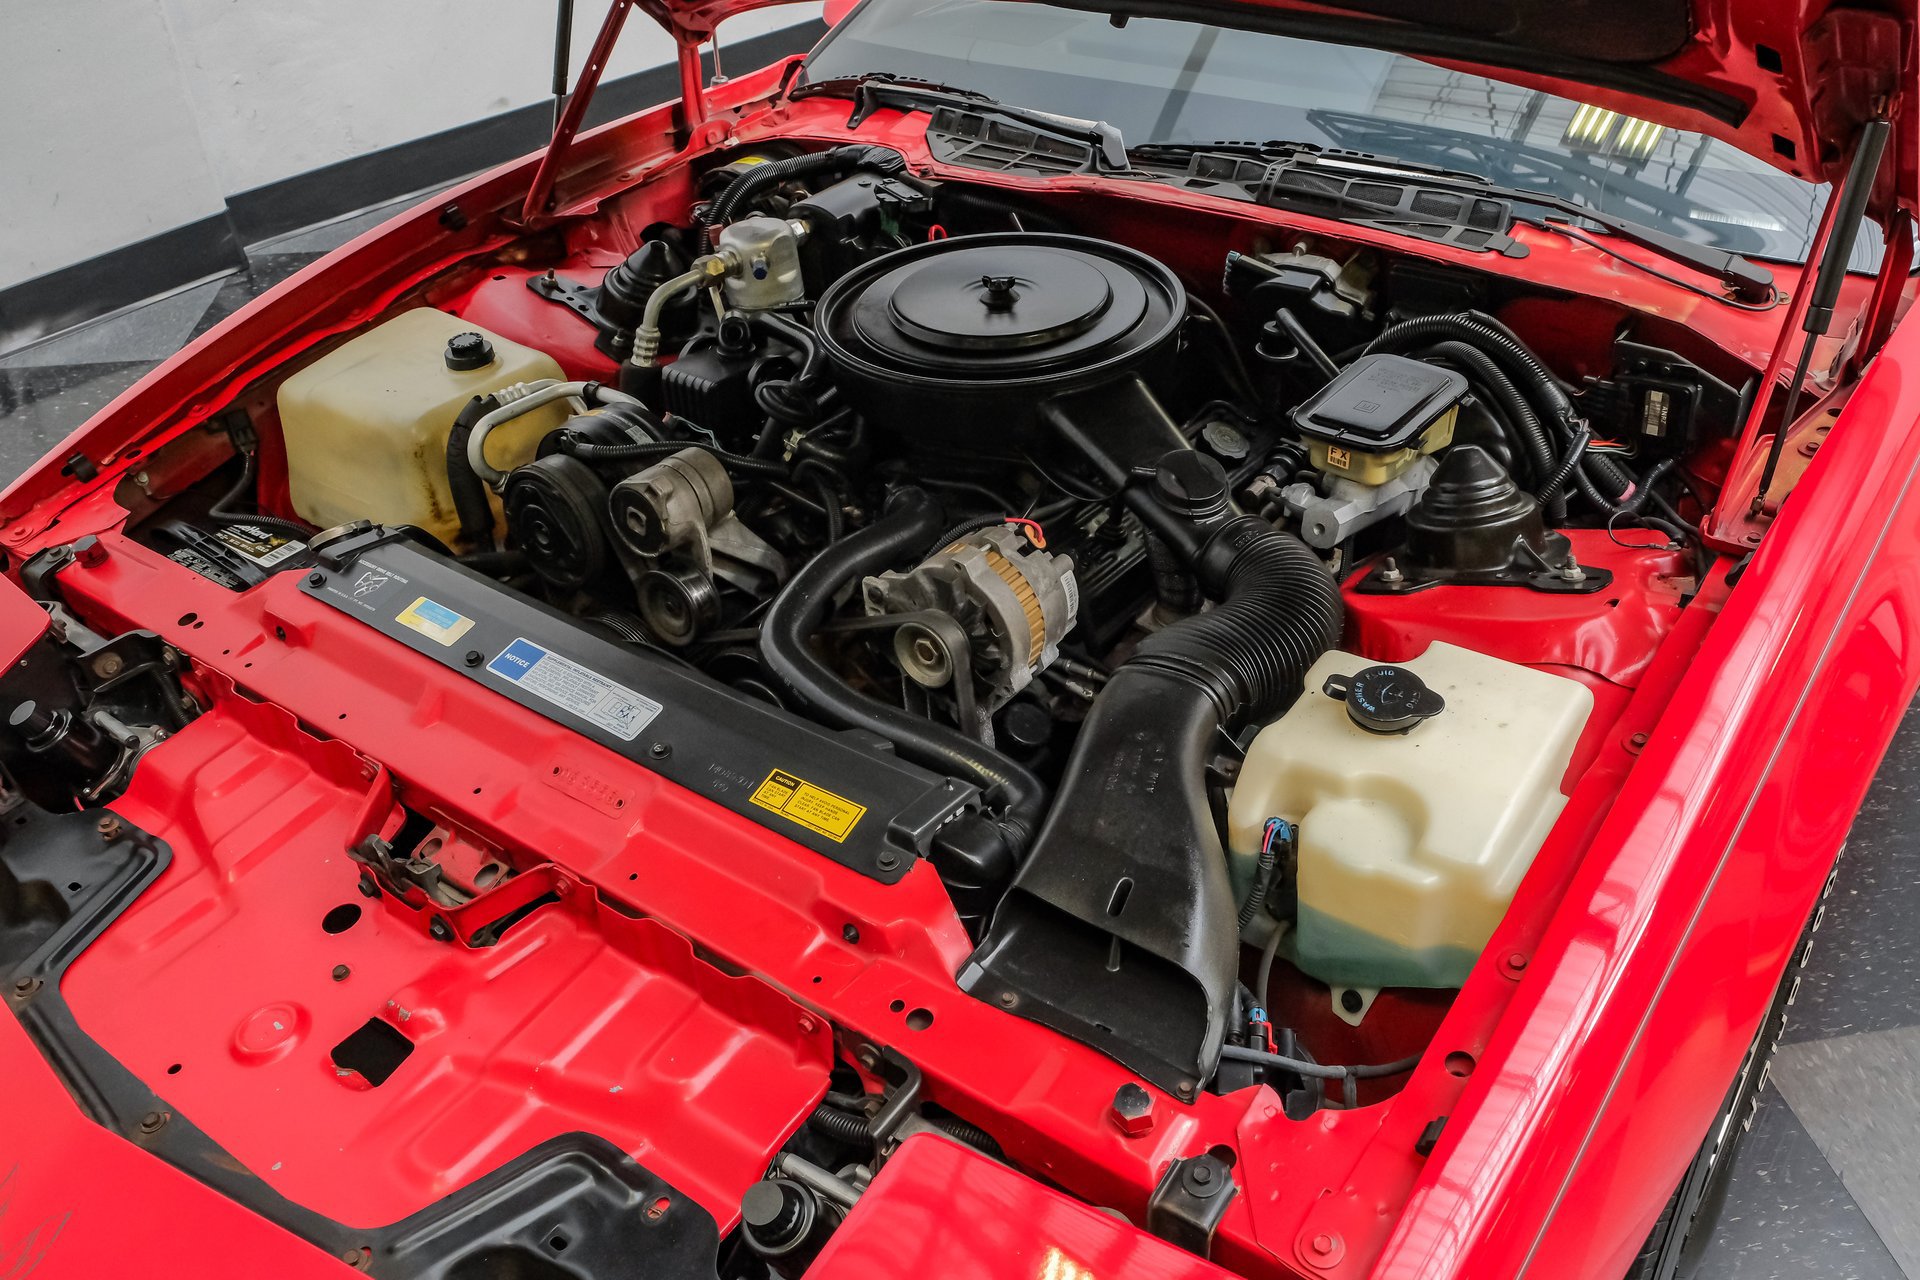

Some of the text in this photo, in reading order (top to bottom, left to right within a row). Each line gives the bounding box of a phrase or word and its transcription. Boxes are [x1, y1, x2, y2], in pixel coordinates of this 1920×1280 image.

[505, 653, 530, 668] NOTICE
[1354, 669, 1395, 712] WASHER FLUID
[775, 775, 796, 788] CAUTION
